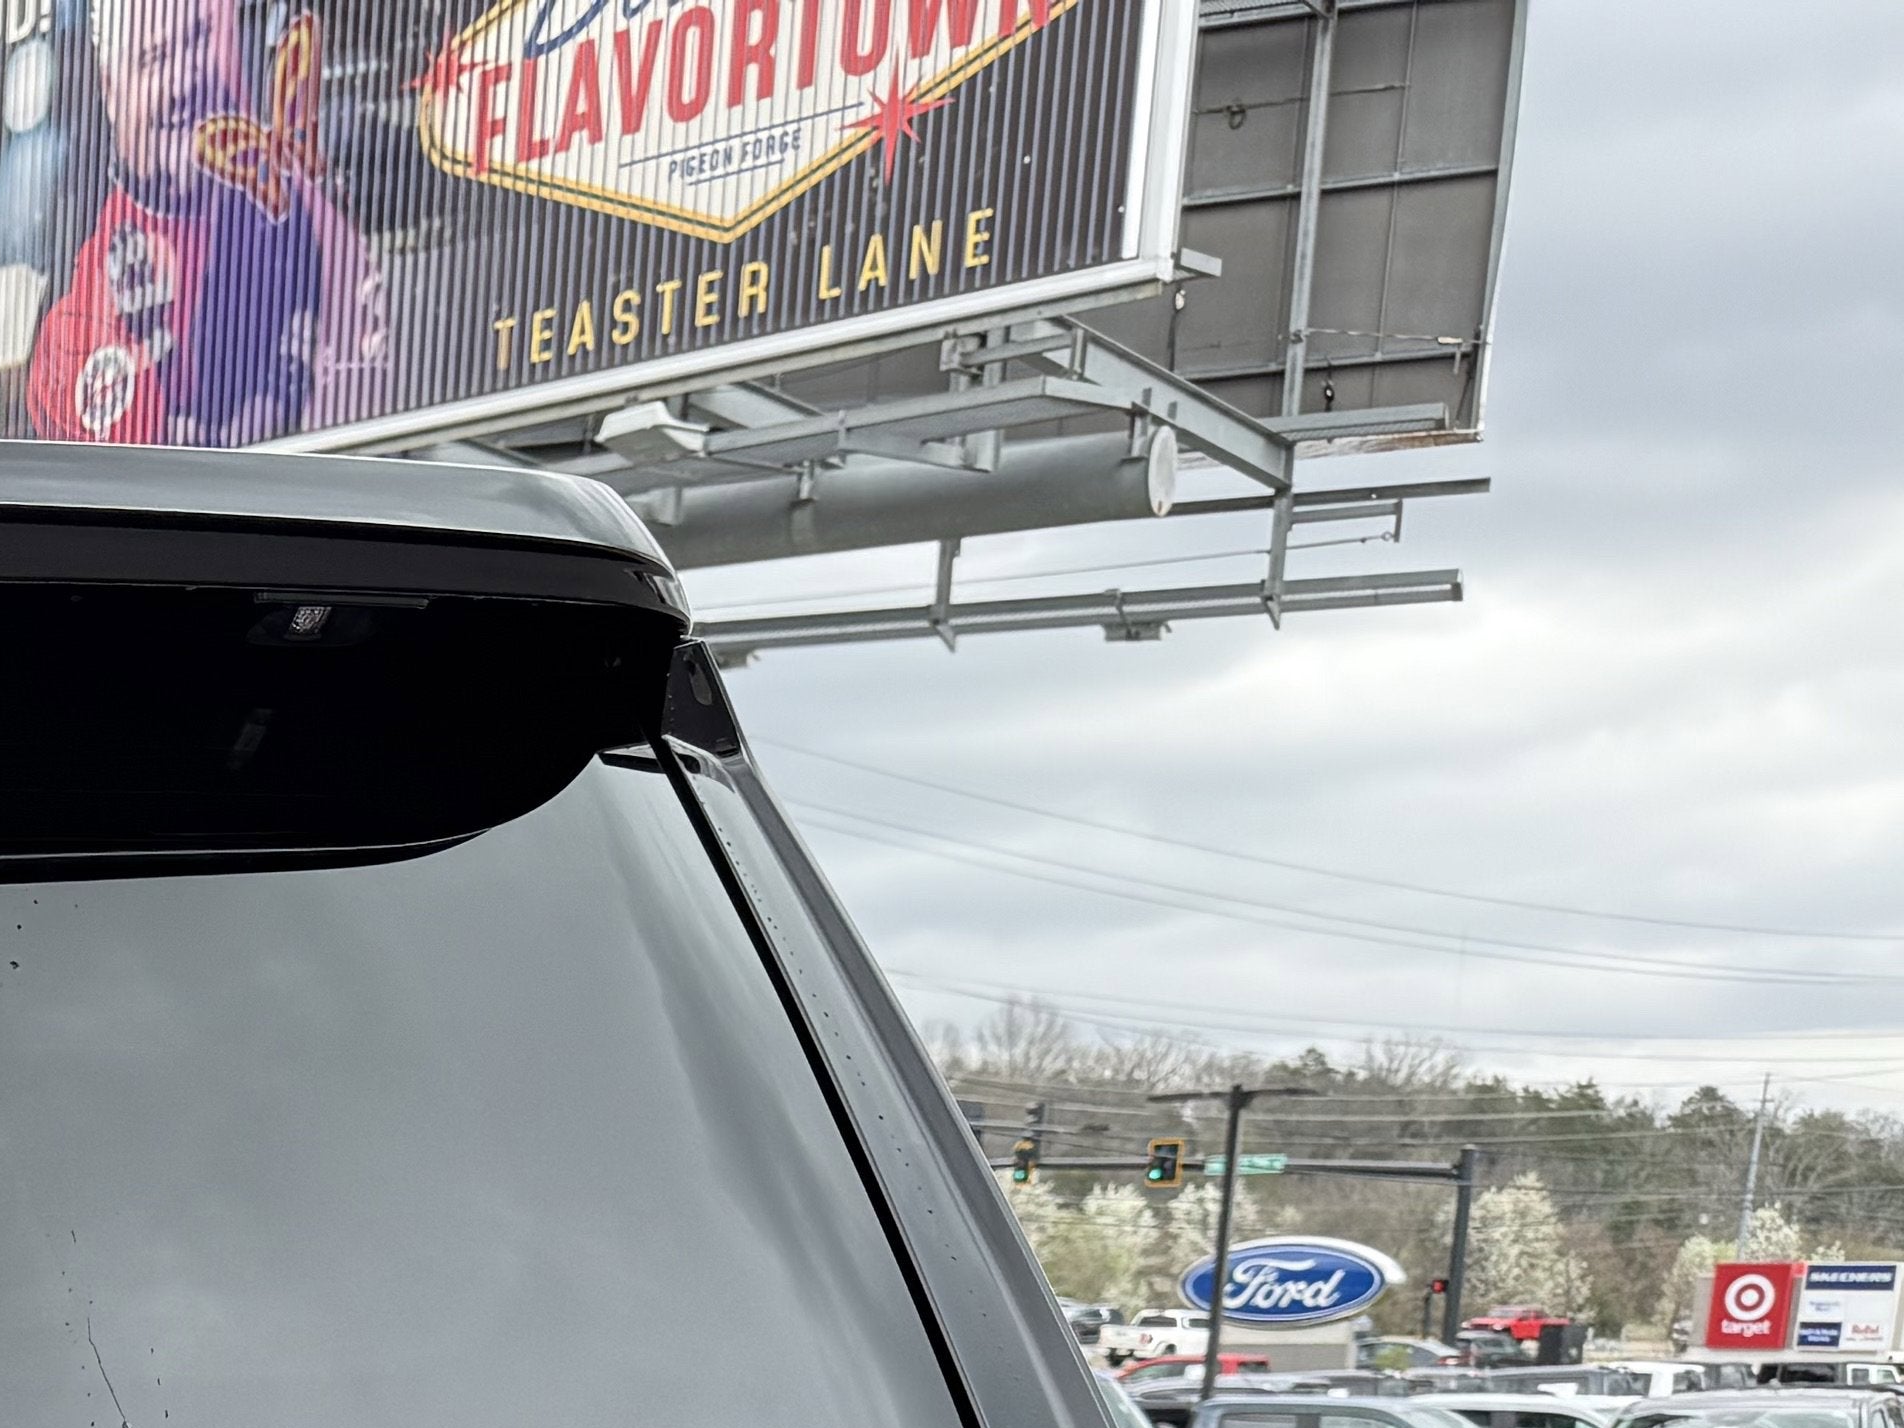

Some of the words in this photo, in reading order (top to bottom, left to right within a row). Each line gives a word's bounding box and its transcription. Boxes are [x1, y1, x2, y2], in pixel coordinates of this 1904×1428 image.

[472, 0, 1052, 178] FLAVORTO
[668, 139, 735, 184] PIGEON
[741, 127, 803, 166] FORGE
[493, 261, 768, 370] TEASTER
[819, 207, 995, 300] LANE
[1222, 1258, 1346, 1310] Ford
[1721, 1319, 1772, 1337] target
